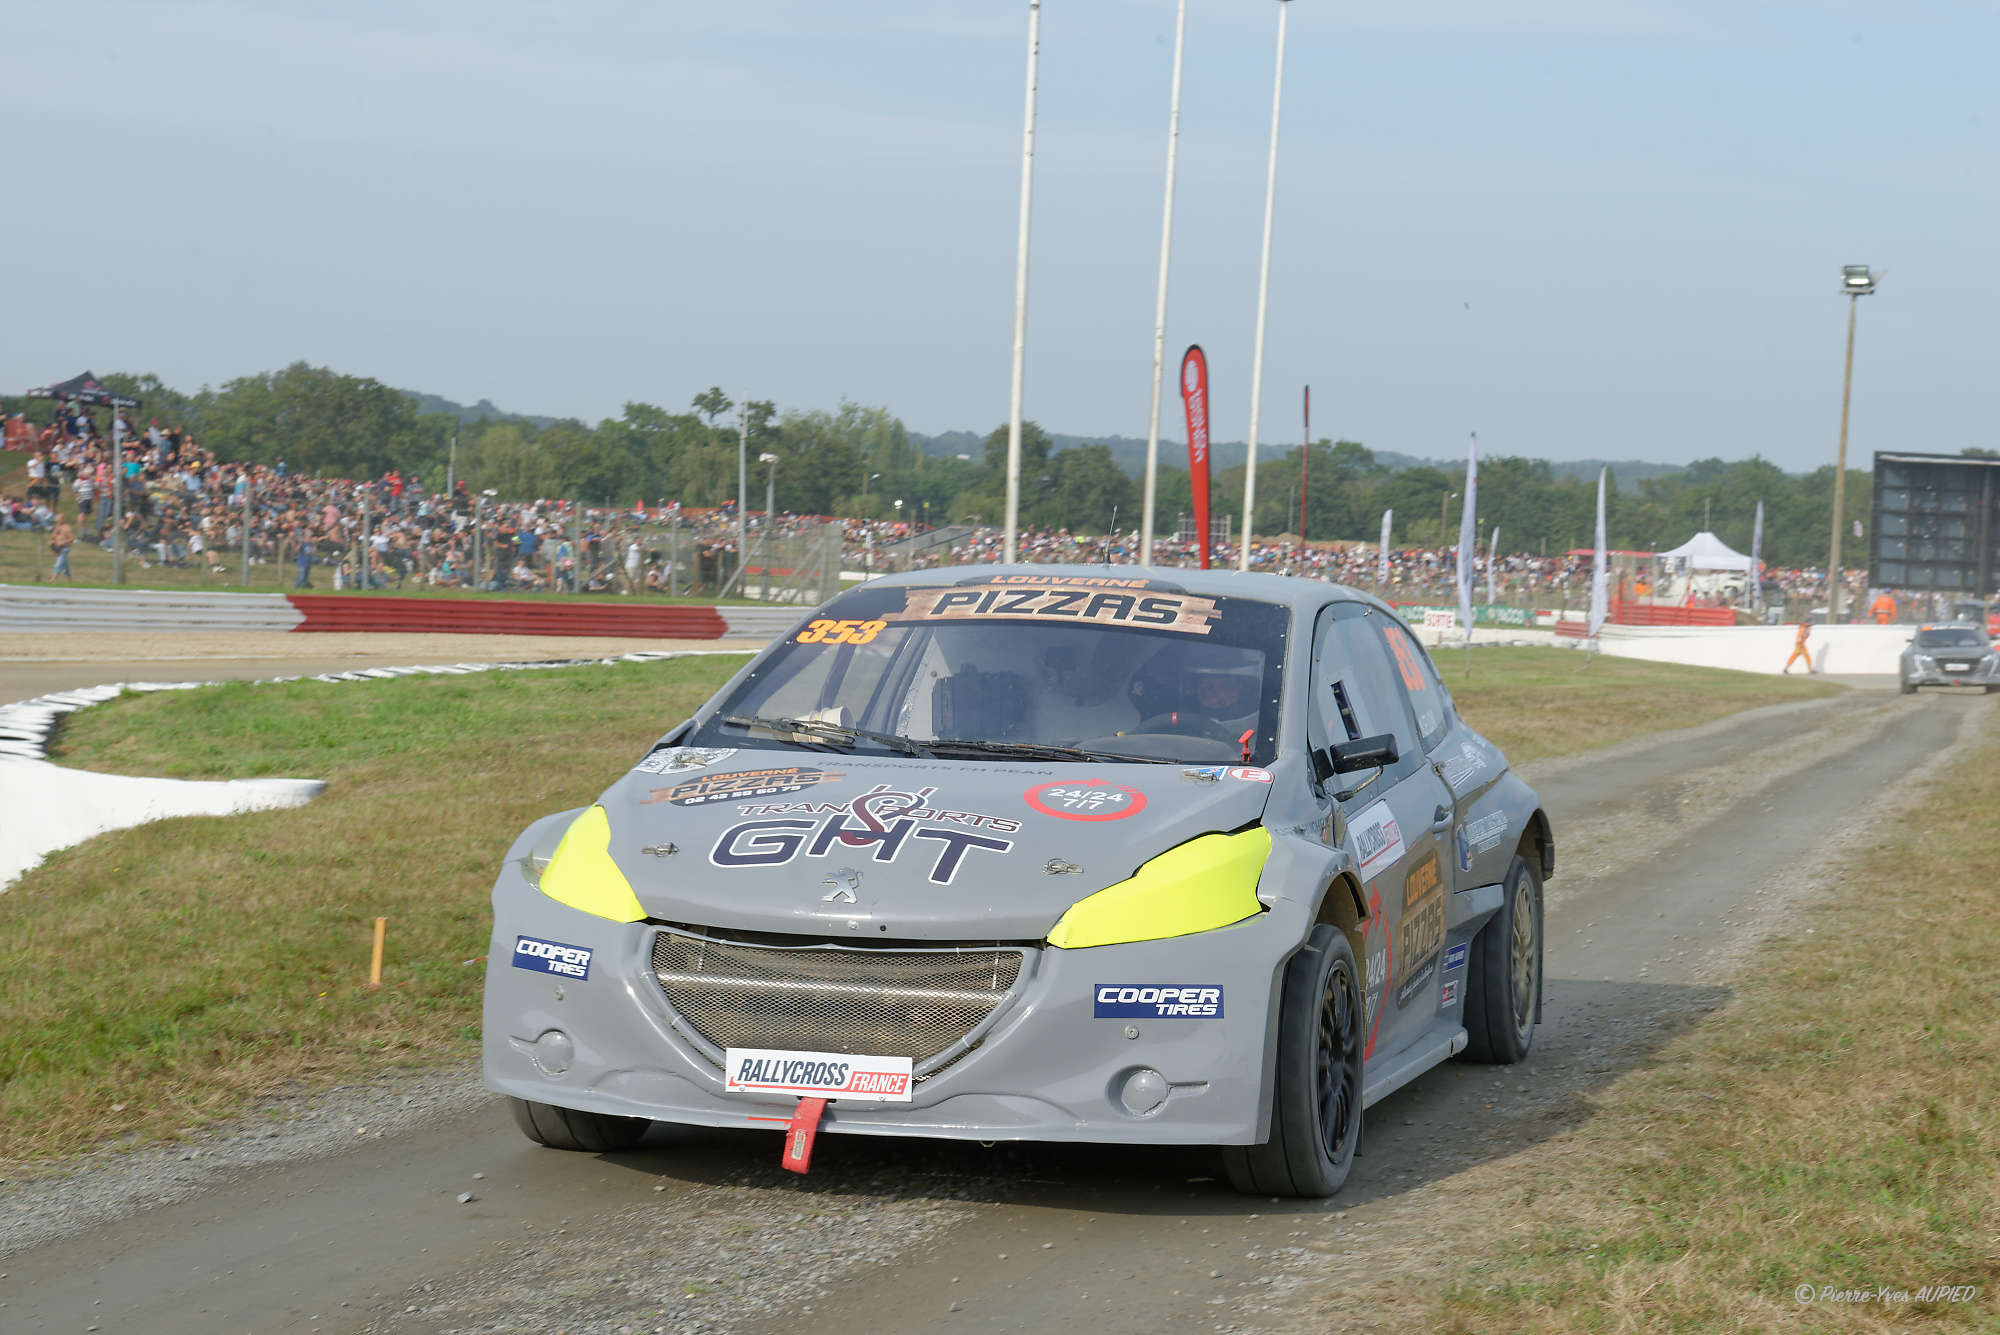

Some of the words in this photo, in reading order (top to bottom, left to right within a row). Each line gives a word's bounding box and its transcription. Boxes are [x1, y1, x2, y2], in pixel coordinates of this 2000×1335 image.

[990, 575, 1150, 589] LOUVERNÉ
[928, 590, 1184, 625] PIZZAS
[796, 619, 888, 645] 353
[701, 767, 799, 782] LOUVERNÉ
[671, 772, 824, 798] PIZZAS
[1048, 788, 1125, 802] 24/24
[1063, 798, 1104, 810] 7/7
[709, 814, 1014, 886] GHT
[516, 939, 591, 966] COOPER
[547, 960, 587, 977] TIRES
[1097, 987, 1220, 1004] COOPER
[1155, 1003, 1218, 1016] TIRES
[738, 1058, 849, 1086] RALLYCROSS
[850, 1074, 908, 1093] FRANCE
